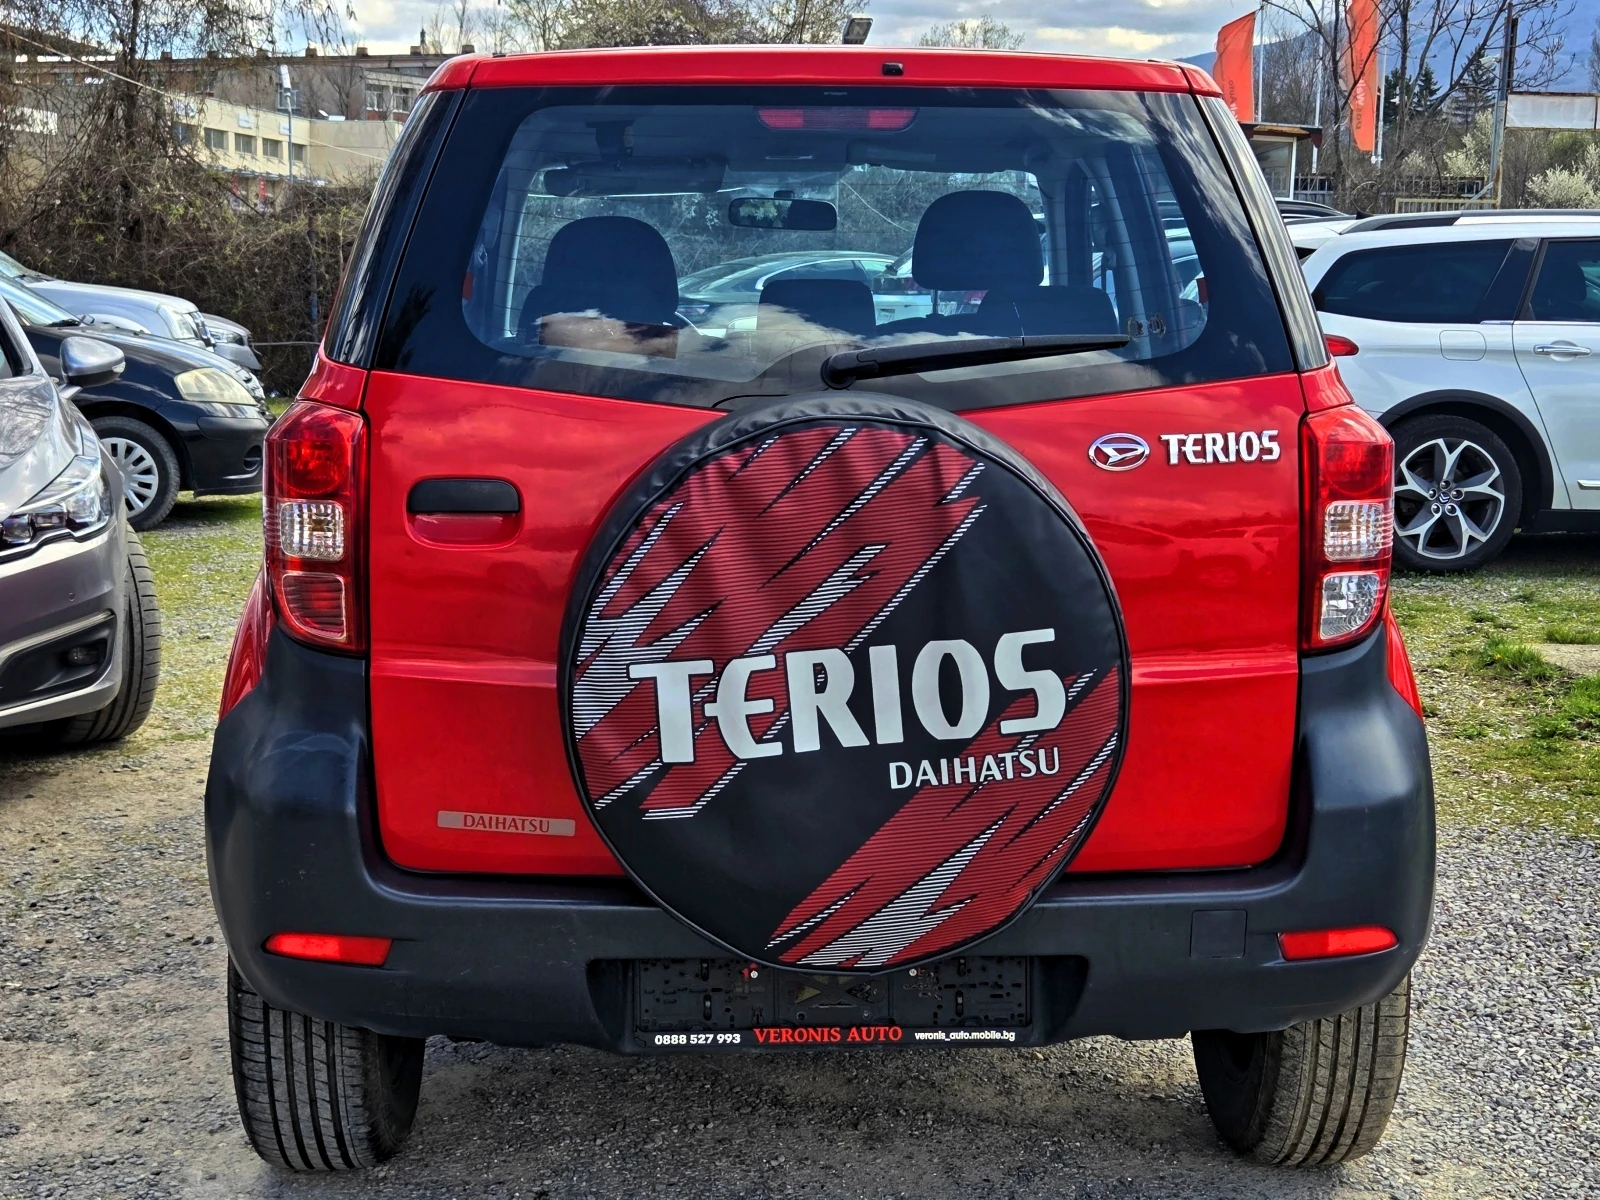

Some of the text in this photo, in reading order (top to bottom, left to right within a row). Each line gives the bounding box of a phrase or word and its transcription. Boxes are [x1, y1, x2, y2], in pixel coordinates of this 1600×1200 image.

[1160, 429, 1281, 465] TERIOS
[629, 628, 1066, 763] TERIOS
[889, 747, 1061, 790] DAIHATSU
[463, 814, 550, 833] DAIHATSU
[654, 1026, 1016, 1045] 0888 527 993 VERONIS AUTO veronis_auto.mobile.bg
